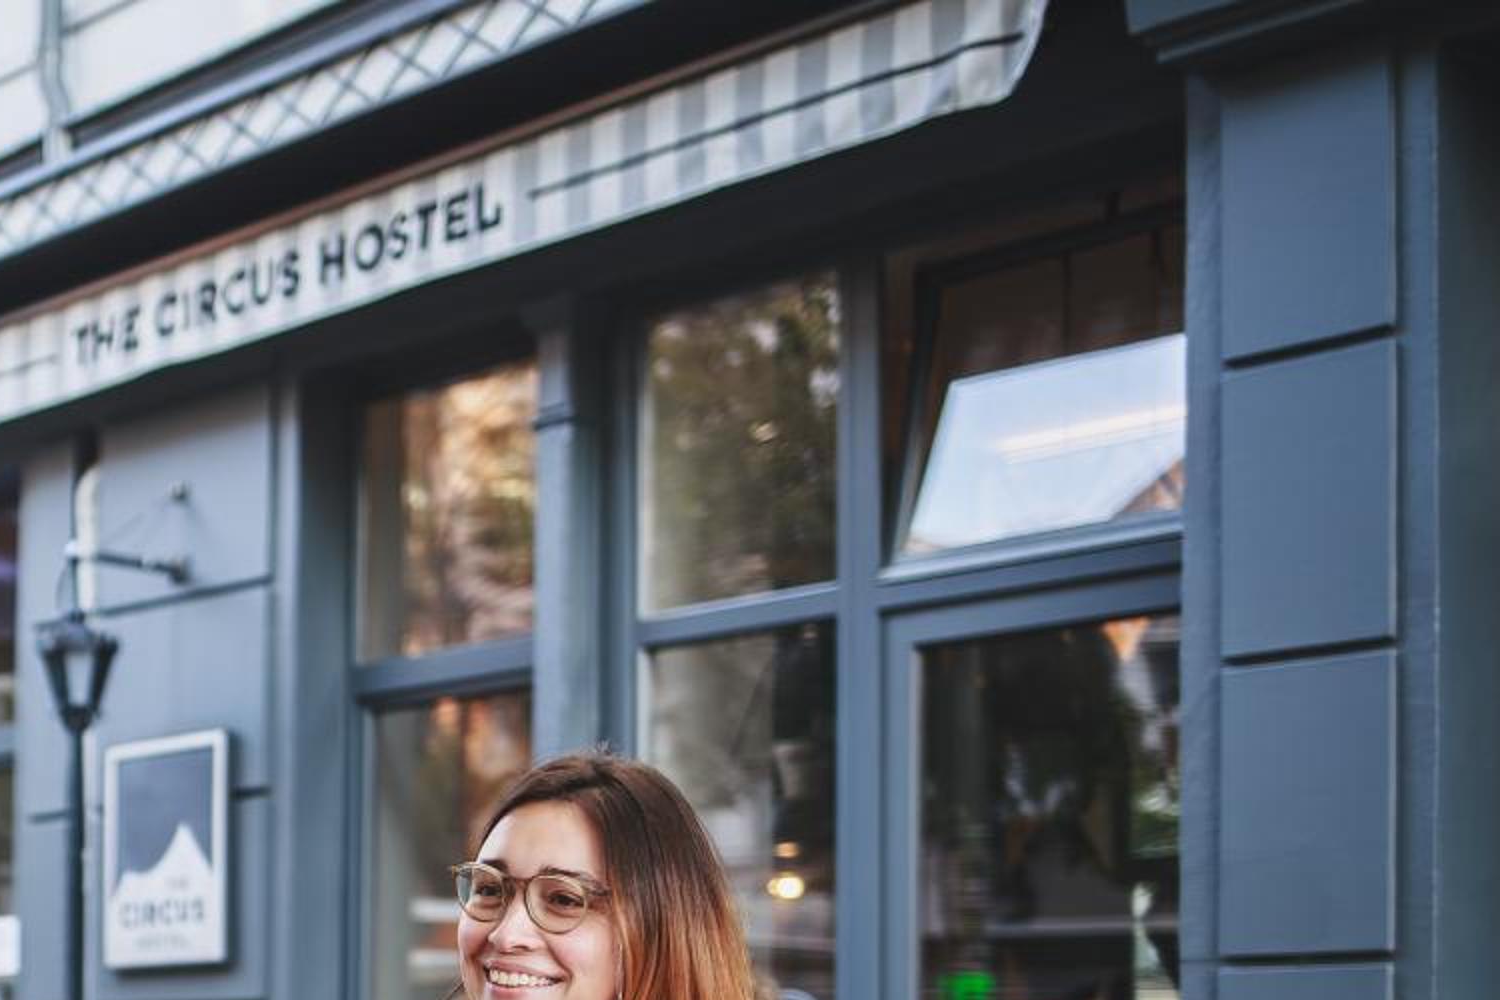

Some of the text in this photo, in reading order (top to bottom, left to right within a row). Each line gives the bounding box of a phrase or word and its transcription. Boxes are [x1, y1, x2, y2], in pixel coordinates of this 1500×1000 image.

[73, 183, 503, 365] THE CIRCUS HOSTEL
[117, 896, 205, 930] CIRCUS
